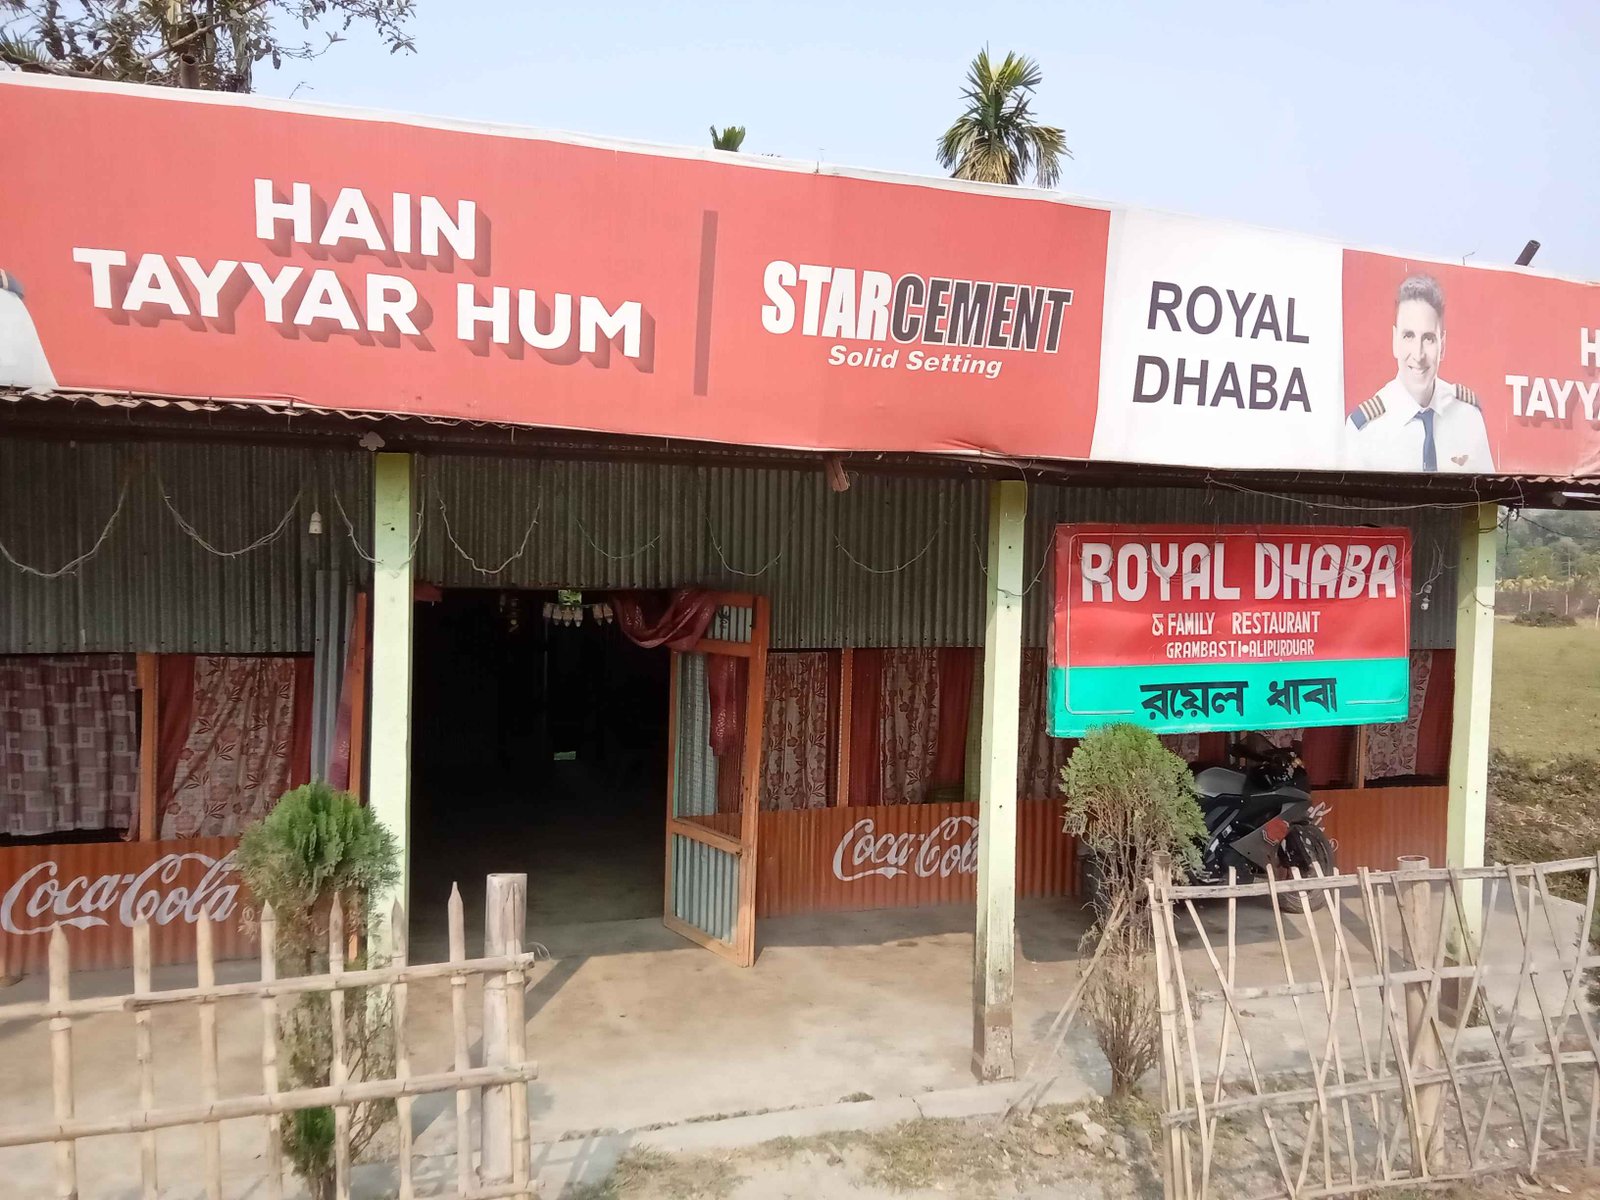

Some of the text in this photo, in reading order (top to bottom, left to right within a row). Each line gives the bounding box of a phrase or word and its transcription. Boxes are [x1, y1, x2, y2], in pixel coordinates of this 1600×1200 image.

[254, 178, 477, 260] HAIN
[72, 247, 643, 359] TAYYAR HUM
[1147, 280, 1310, 344] ROYAL
[827, 344, 1003, 380] Solid Setting
[1132, 354, 1313, 413] DHABA
[1505, 374, 1600, 422] TAYY
[1080, 542, 1397, 602] ROYAL DHABA
[1232, 611, 1321, 635] RESTAURANT
[1139, 677, 1338, 721] রয়েল ধাবা
[0, 851, 241, 936] Coca-Cola
